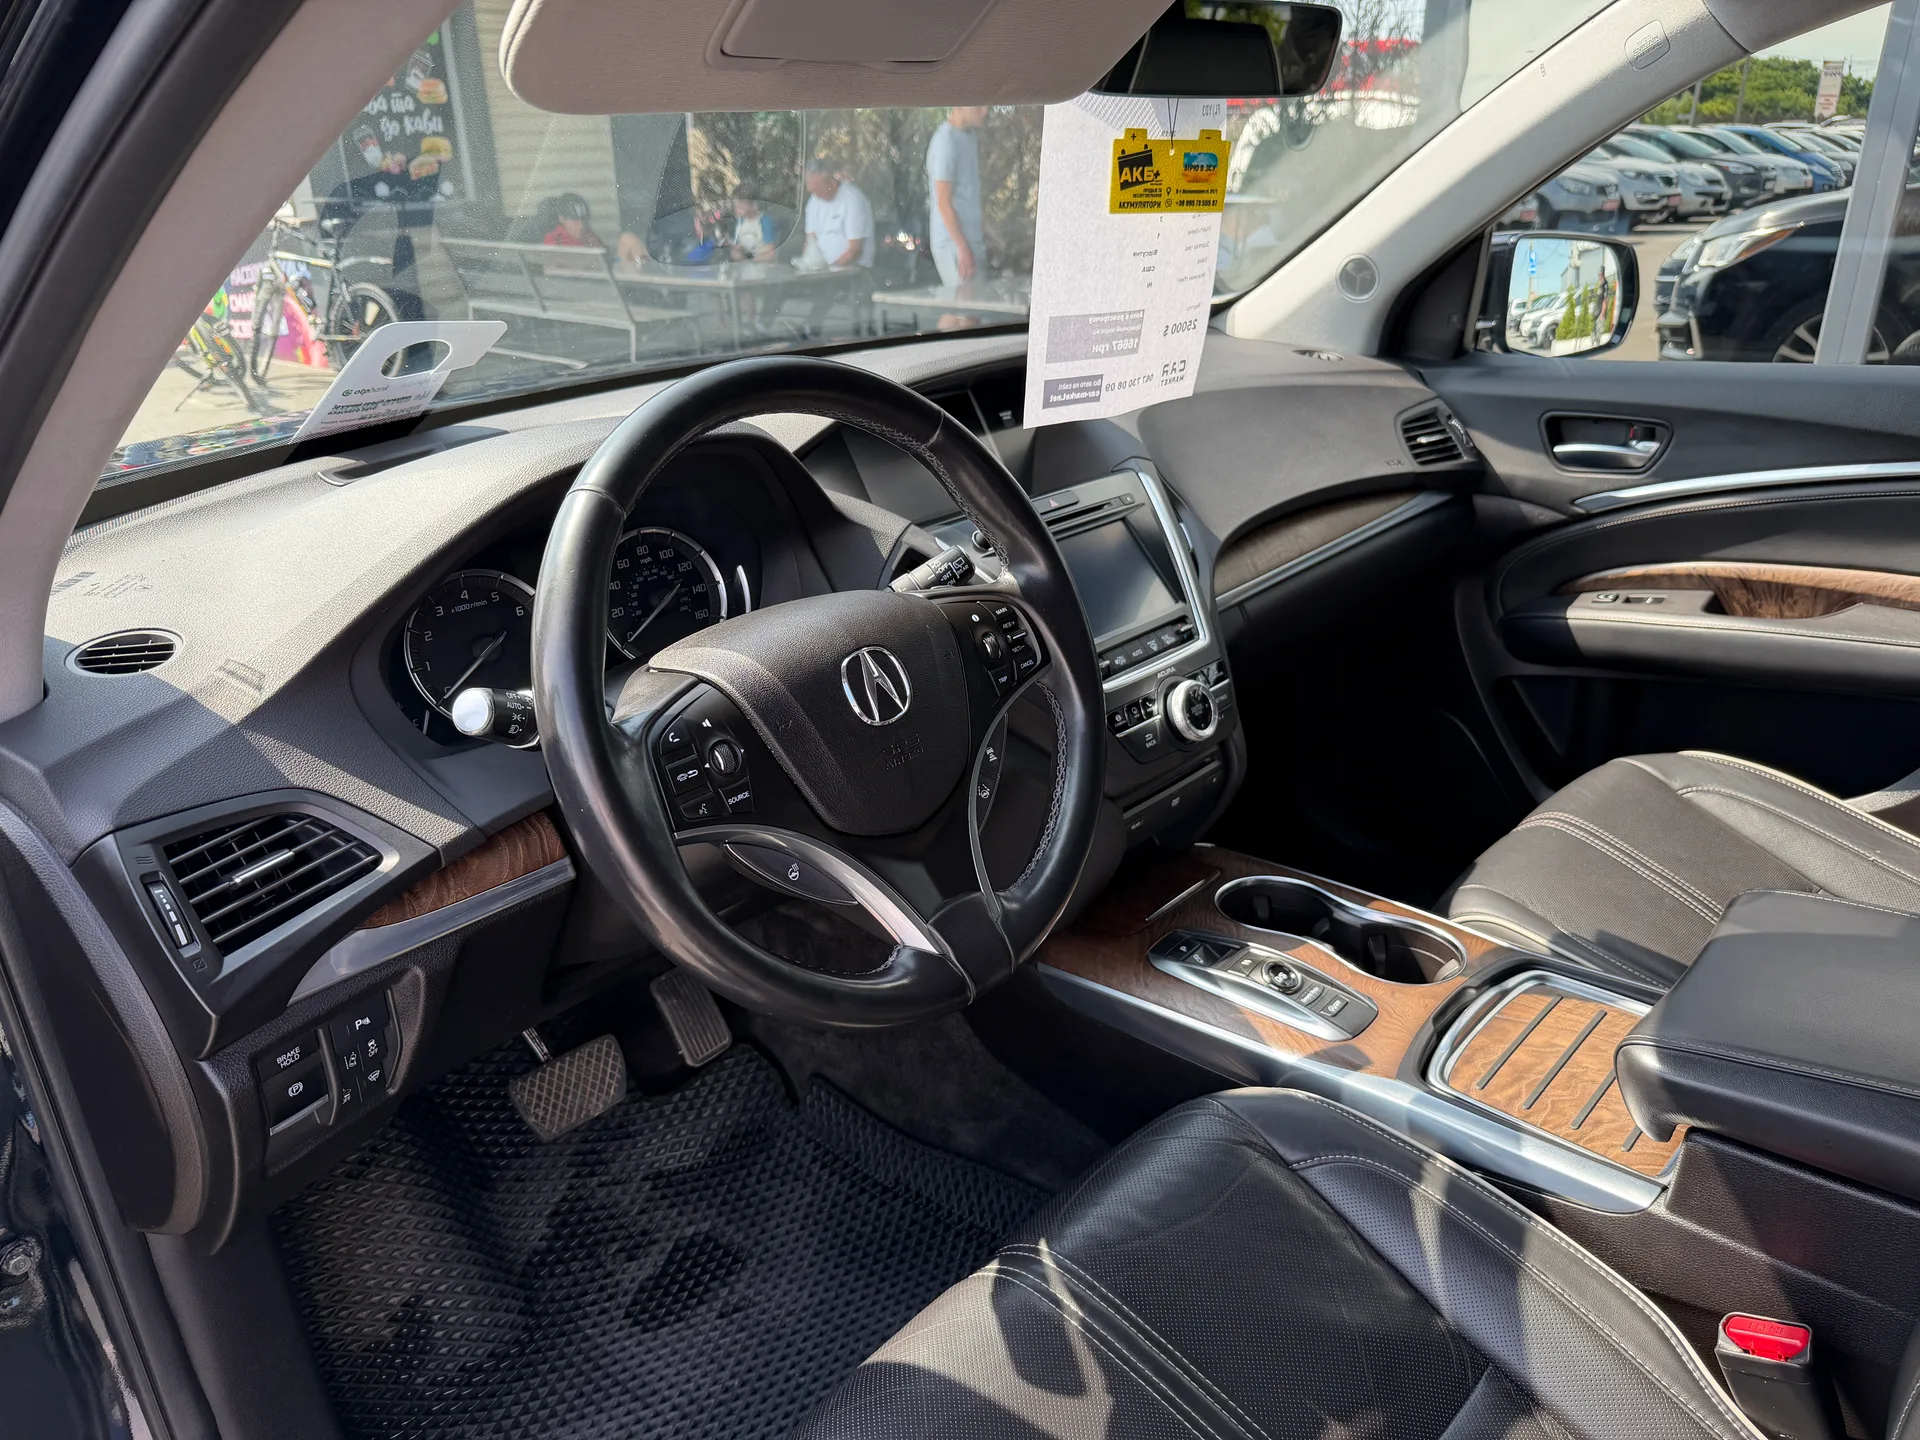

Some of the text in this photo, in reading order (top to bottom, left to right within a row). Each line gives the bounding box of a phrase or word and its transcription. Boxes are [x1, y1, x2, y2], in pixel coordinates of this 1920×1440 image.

[1118, 201, 1162, 209] АКУМУЛЯТОРИ
[636, 545, 649, 556] 80
[659, 548, 674, 560] 100
[617, 558, 630, 570] 60
[640, 556, 652, 565] mph
[677, 561, 693, 573] 120
[609, 581, 621, 591] 40
[692, 583, 707, 595] 140
[460, 589, 469, 600] 4
[491, 591, 500, 602] 5
[435, 606, 444, 617] 3
[451, 600, 488, 614] x1000 r/min
[515, 606, 524, 617] 6
[611, 607, 624, 618] 20
[995, 606, 1008, 615] MAIN
[694, 609, 709, 620] 160
[424, 630, 433, 642] 2
[425, 661, 431, 672] 1
[1157, 666, 1176, 679] ACURA
[1145, 739, 1157, 748] BACK
[728, 790, 750, 805] SOURCE
[276, 1045, 301, 1065] BRAKE
[280, 1053, 300, 1069] HOLD
